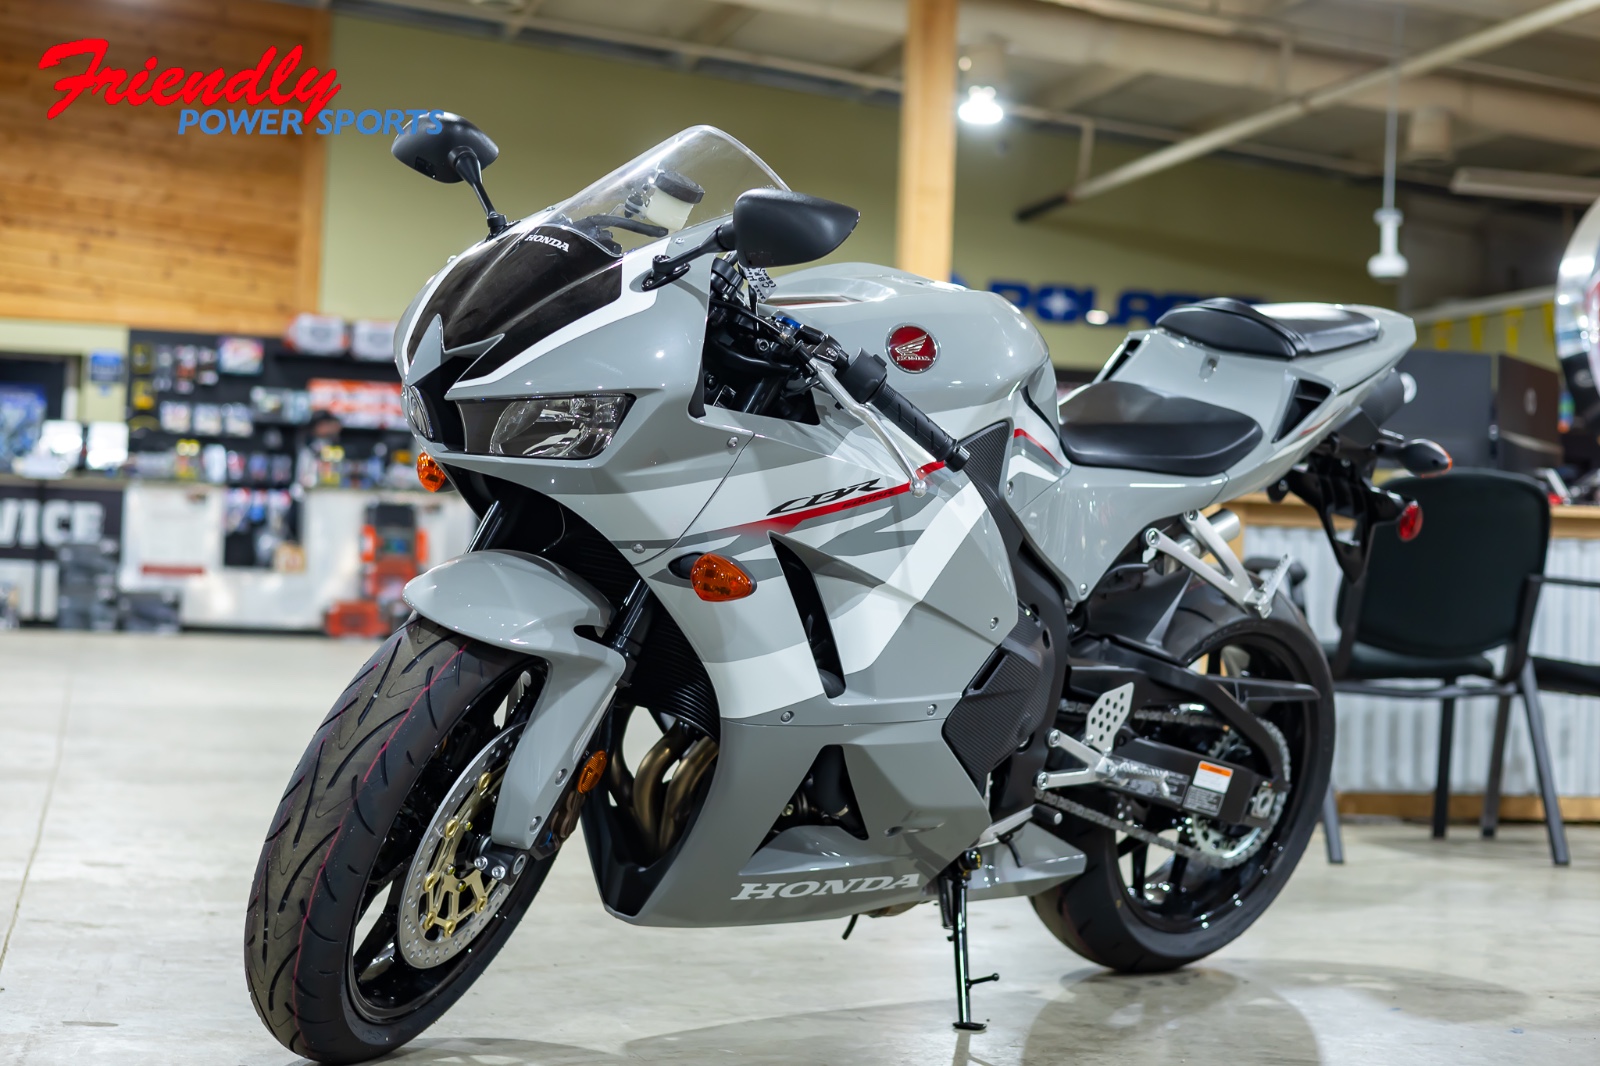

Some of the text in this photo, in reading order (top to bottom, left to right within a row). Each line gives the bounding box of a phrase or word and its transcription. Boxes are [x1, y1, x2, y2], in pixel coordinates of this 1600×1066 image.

[524, 234, 570, 253] HONDA
[766, 478, 884, 516] CBR
[730, 873, 921, 900] HONDA
